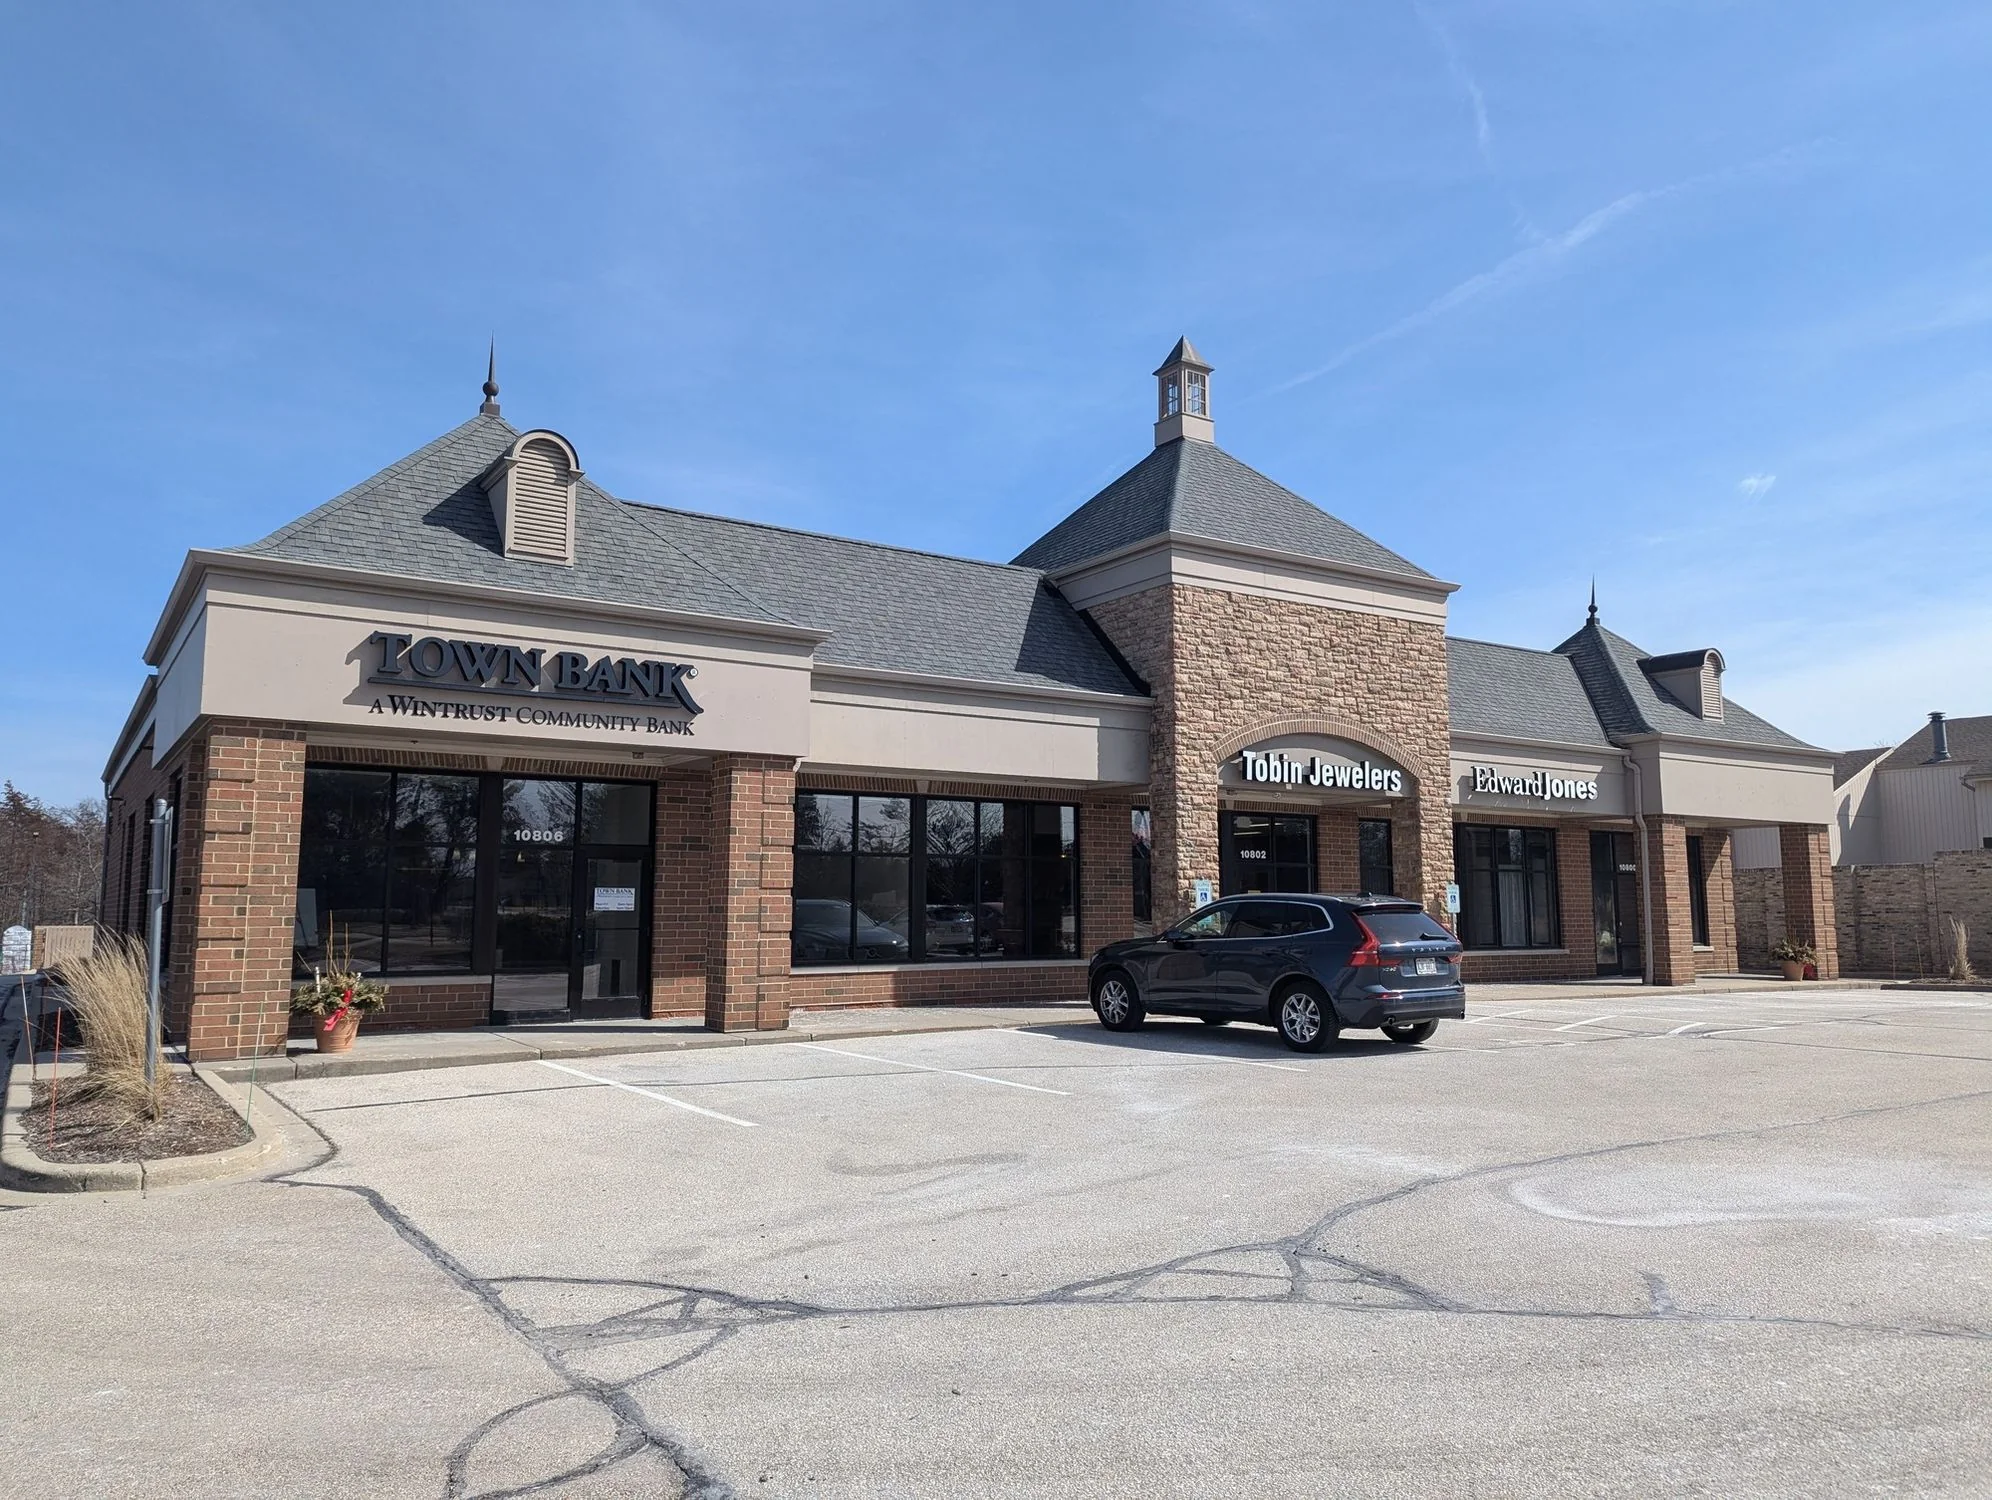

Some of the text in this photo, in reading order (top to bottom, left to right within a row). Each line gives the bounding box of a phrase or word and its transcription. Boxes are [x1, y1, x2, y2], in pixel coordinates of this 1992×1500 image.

[369, 631, 704, 715] TOWN BANK
[368, 694, 695, 736] A WINTRUST COMMUNITY BANK
[1242, 750, 1402, 792] Tobin Jewelers
[513, 829, 564, 842] 10806
[1240, 850, 1267, 859] 10802
